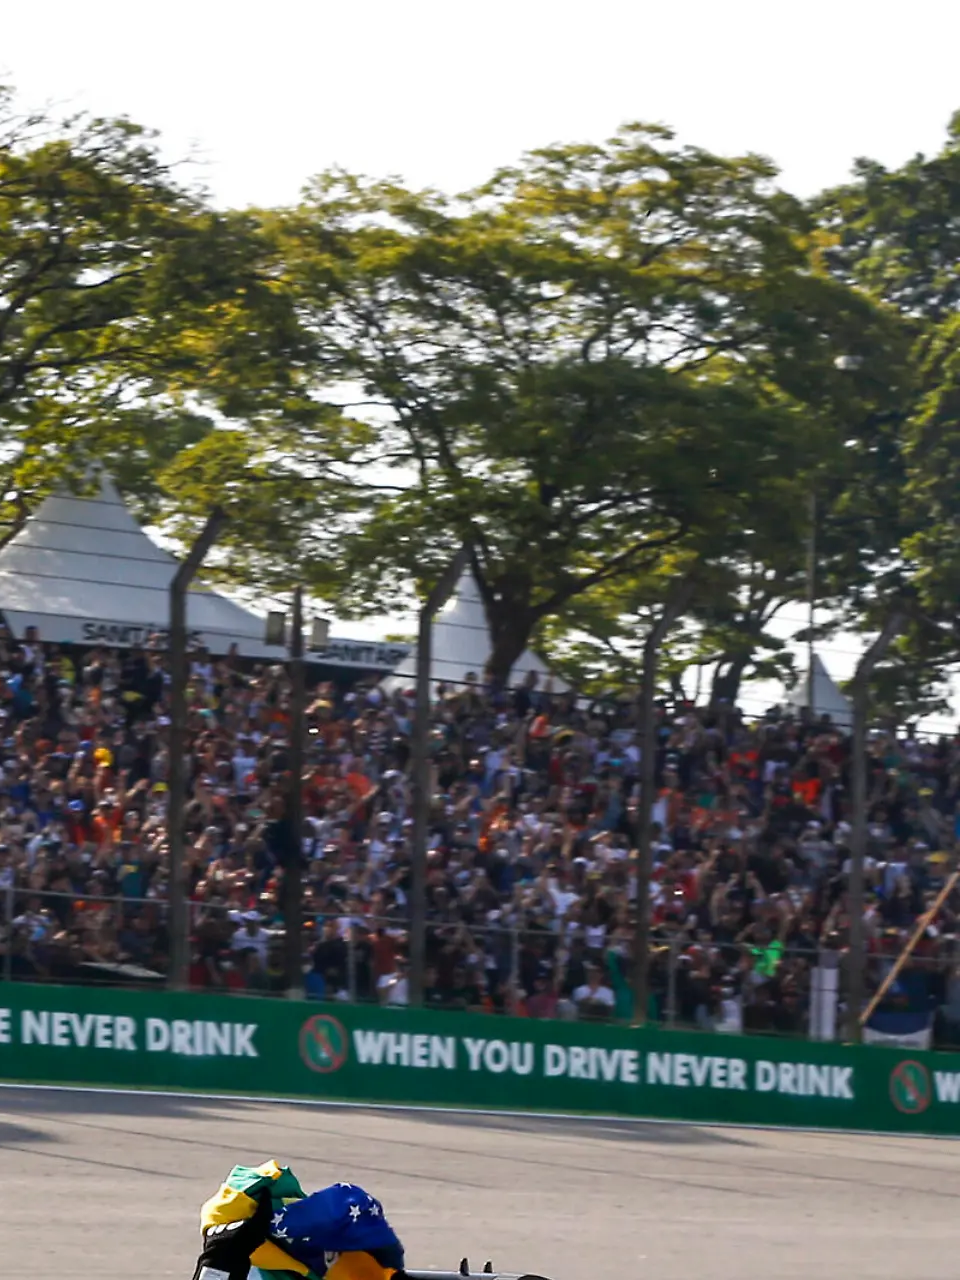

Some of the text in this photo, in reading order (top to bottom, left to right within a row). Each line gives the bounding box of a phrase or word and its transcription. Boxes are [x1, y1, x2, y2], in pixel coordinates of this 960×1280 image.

[22, 1010, 136, 1051] NEVER
[146, 1017, 258, 1057] DRINK
[353, 1030, 854, 1099] WHEN YOU DRIVE NEVER DRINK
